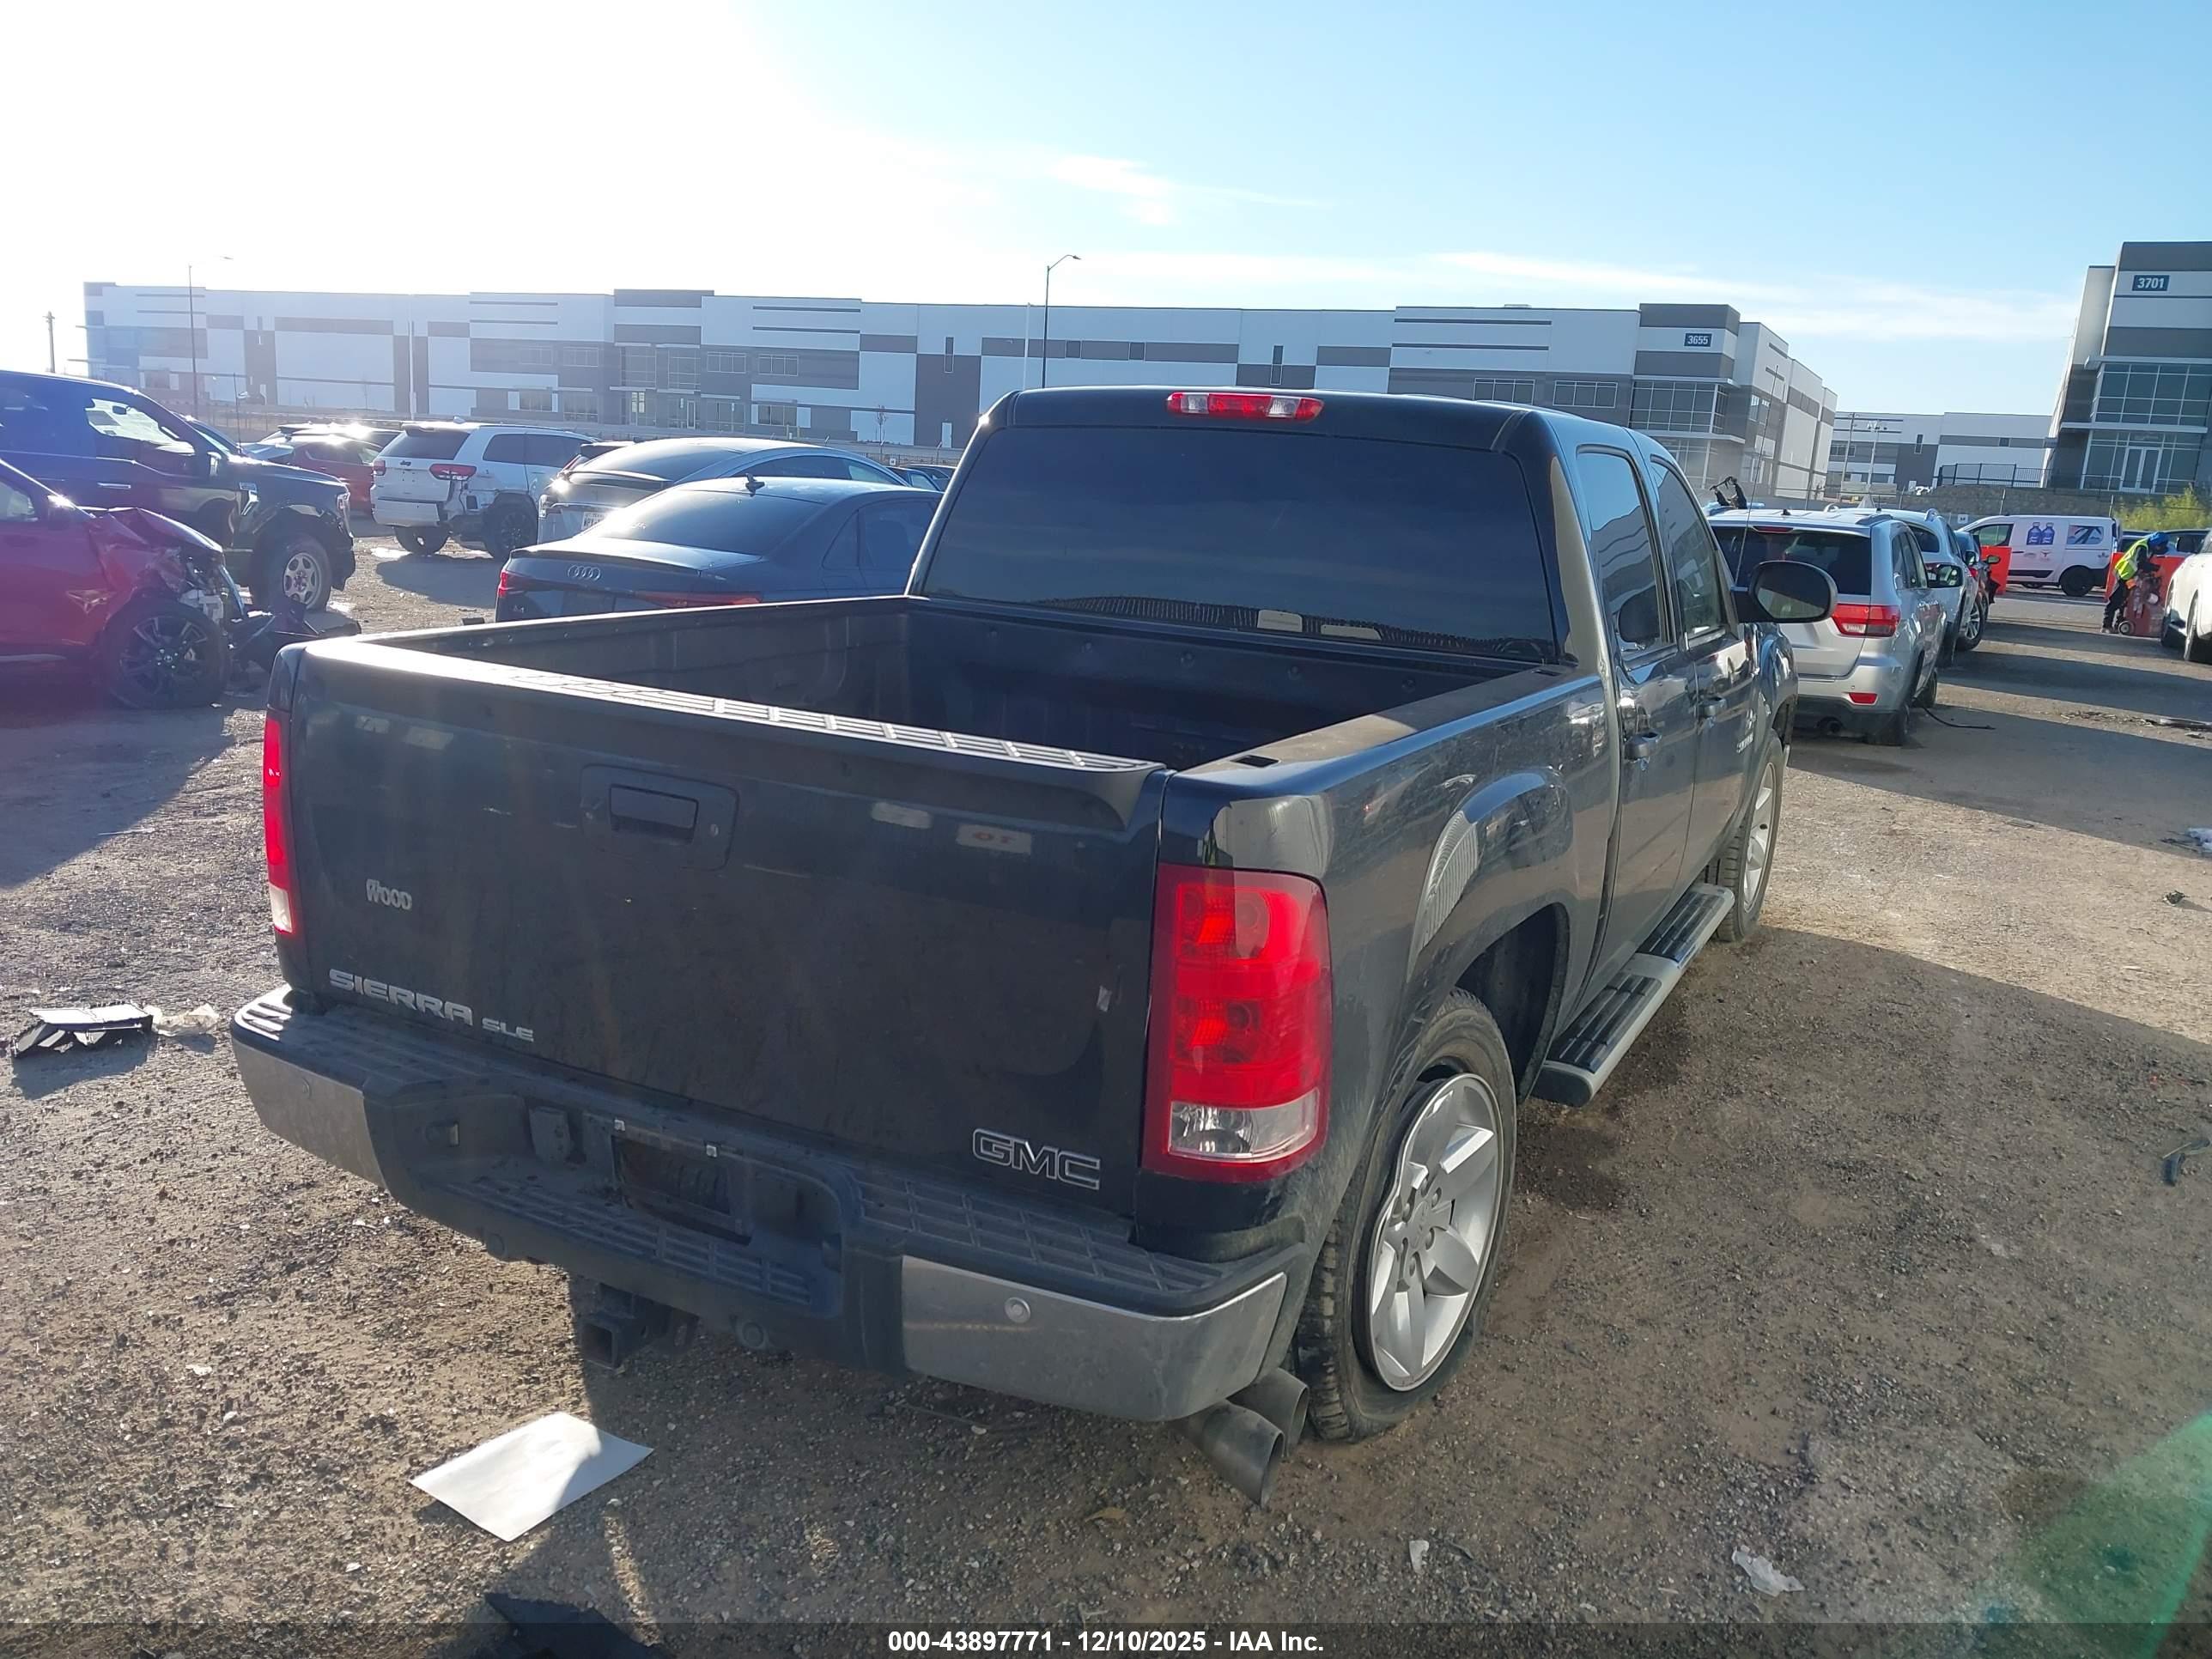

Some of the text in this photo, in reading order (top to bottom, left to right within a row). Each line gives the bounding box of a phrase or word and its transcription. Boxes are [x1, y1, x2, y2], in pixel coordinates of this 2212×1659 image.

[2137, 277, 2165, 289] 3701
[1687, 335, 1709, 345] 3655
[329, 968, 534, 1042] SIERRA SLE
[972, 1127, 1101, 1190] GMC
